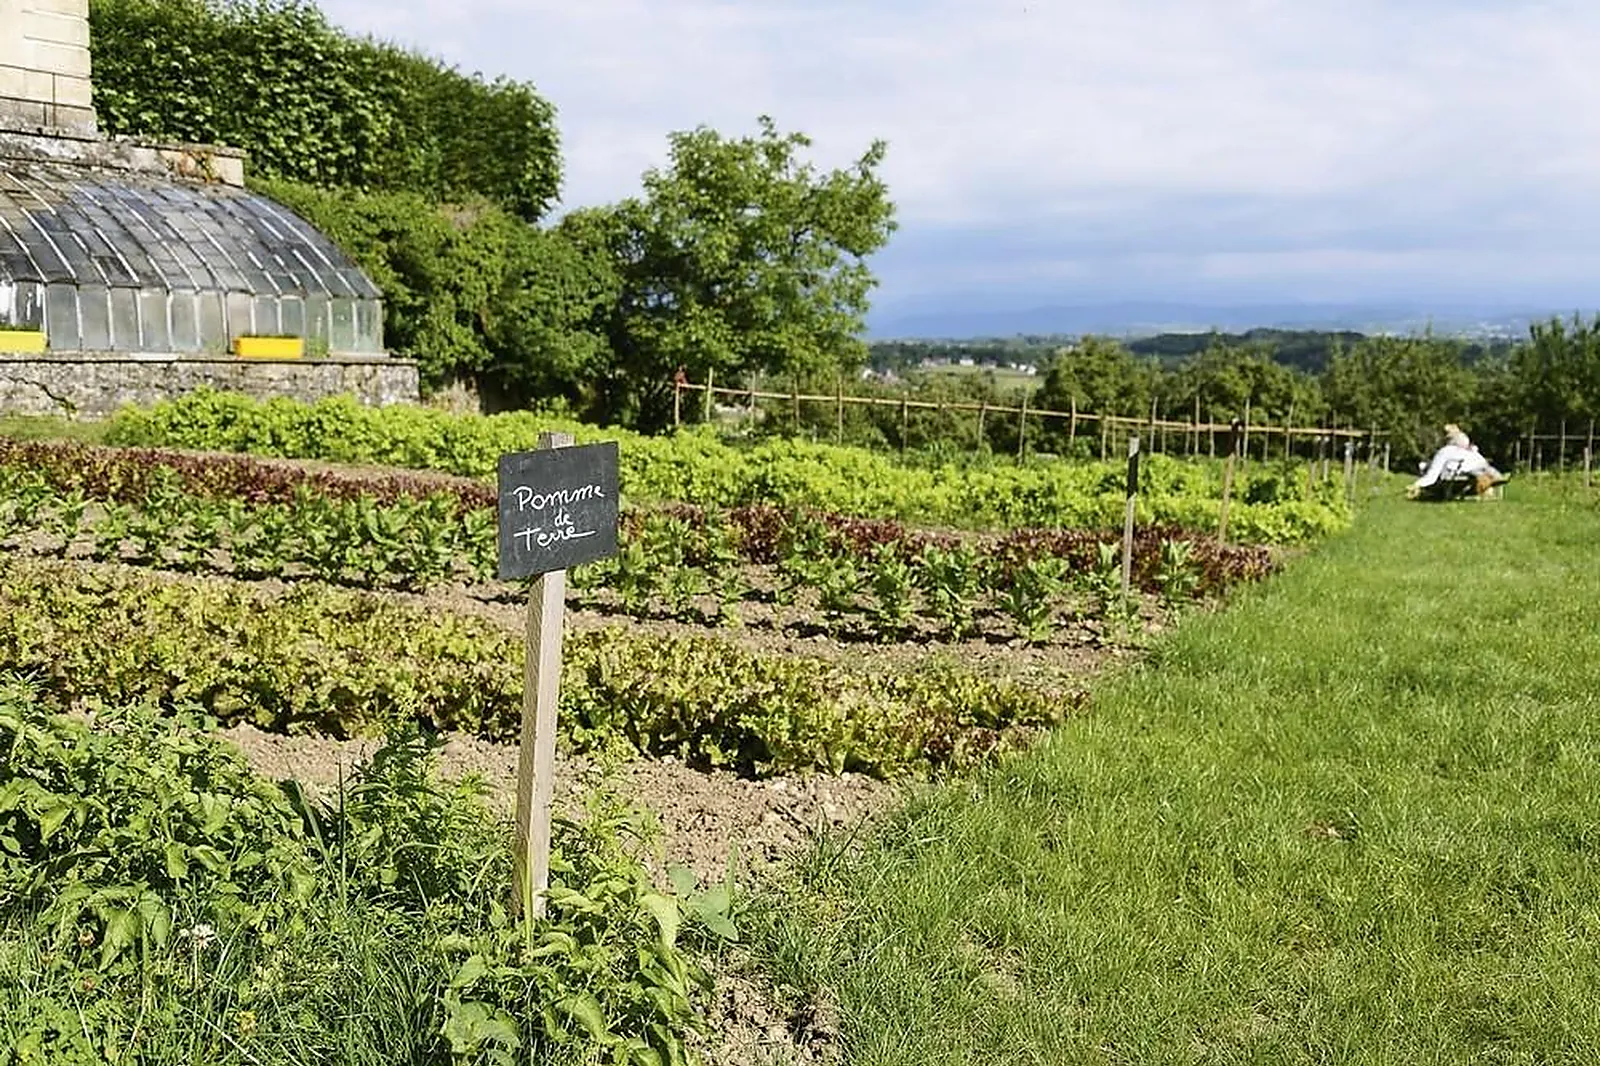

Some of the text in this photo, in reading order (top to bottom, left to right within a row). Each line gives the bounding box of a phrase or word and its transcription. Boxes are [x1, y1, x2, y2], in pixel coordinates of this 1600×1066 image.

[513, 484, 605, 511] Pomme
[554, 508, 573, 527] de
[513, 526, 596, 551] Terre
